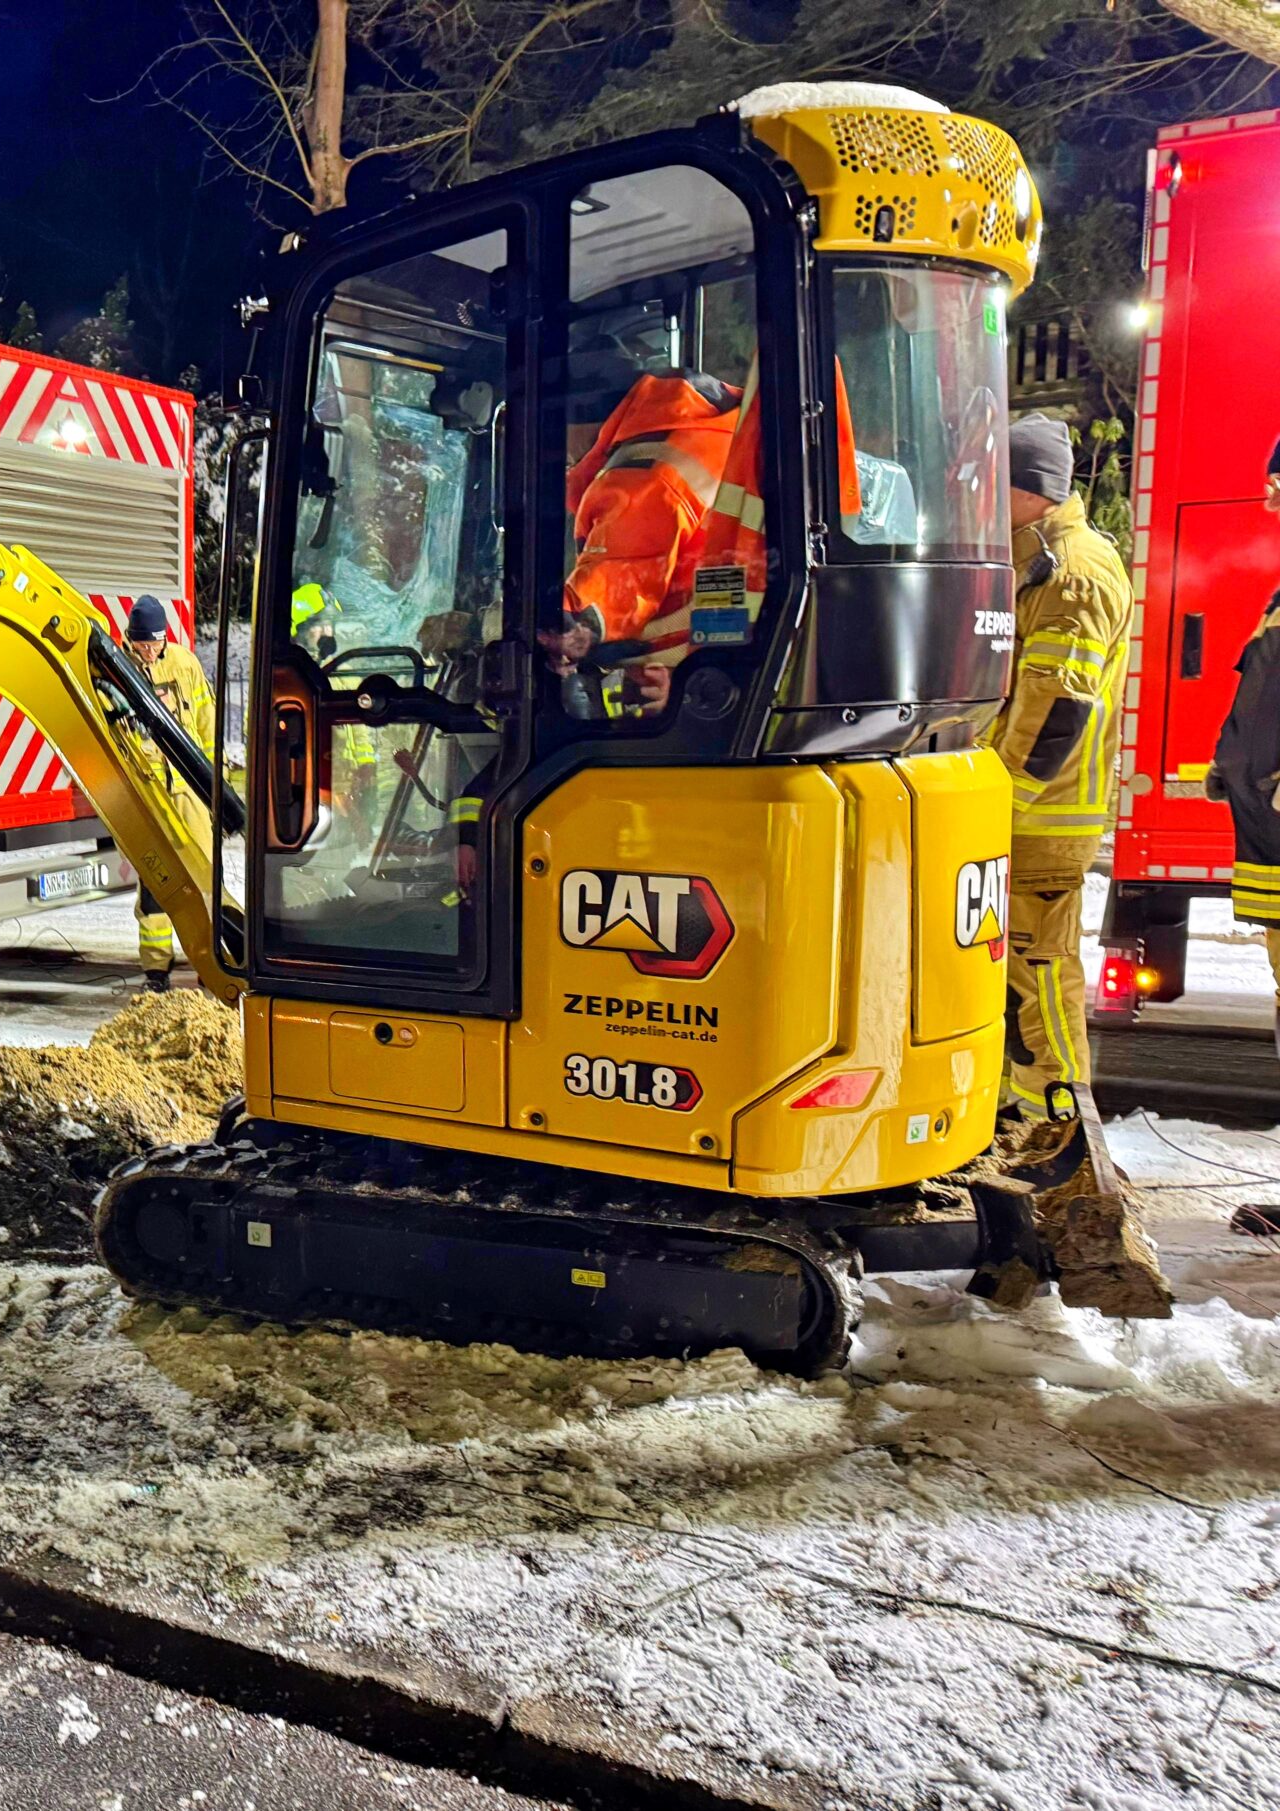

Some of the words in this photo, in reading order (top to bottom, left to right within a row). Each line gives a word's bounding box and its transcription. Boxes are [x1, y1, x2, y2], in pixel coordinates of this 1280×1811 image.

[562, 870, 690, 953] CAT
[956, 855, 1008, 946] CAT
[563, 993, 719, 1028] ZEPPELIN
[605, 1023, 718, 1043] zeppelin-cat.de
[566, 1055, 677, 1107] 301.8
